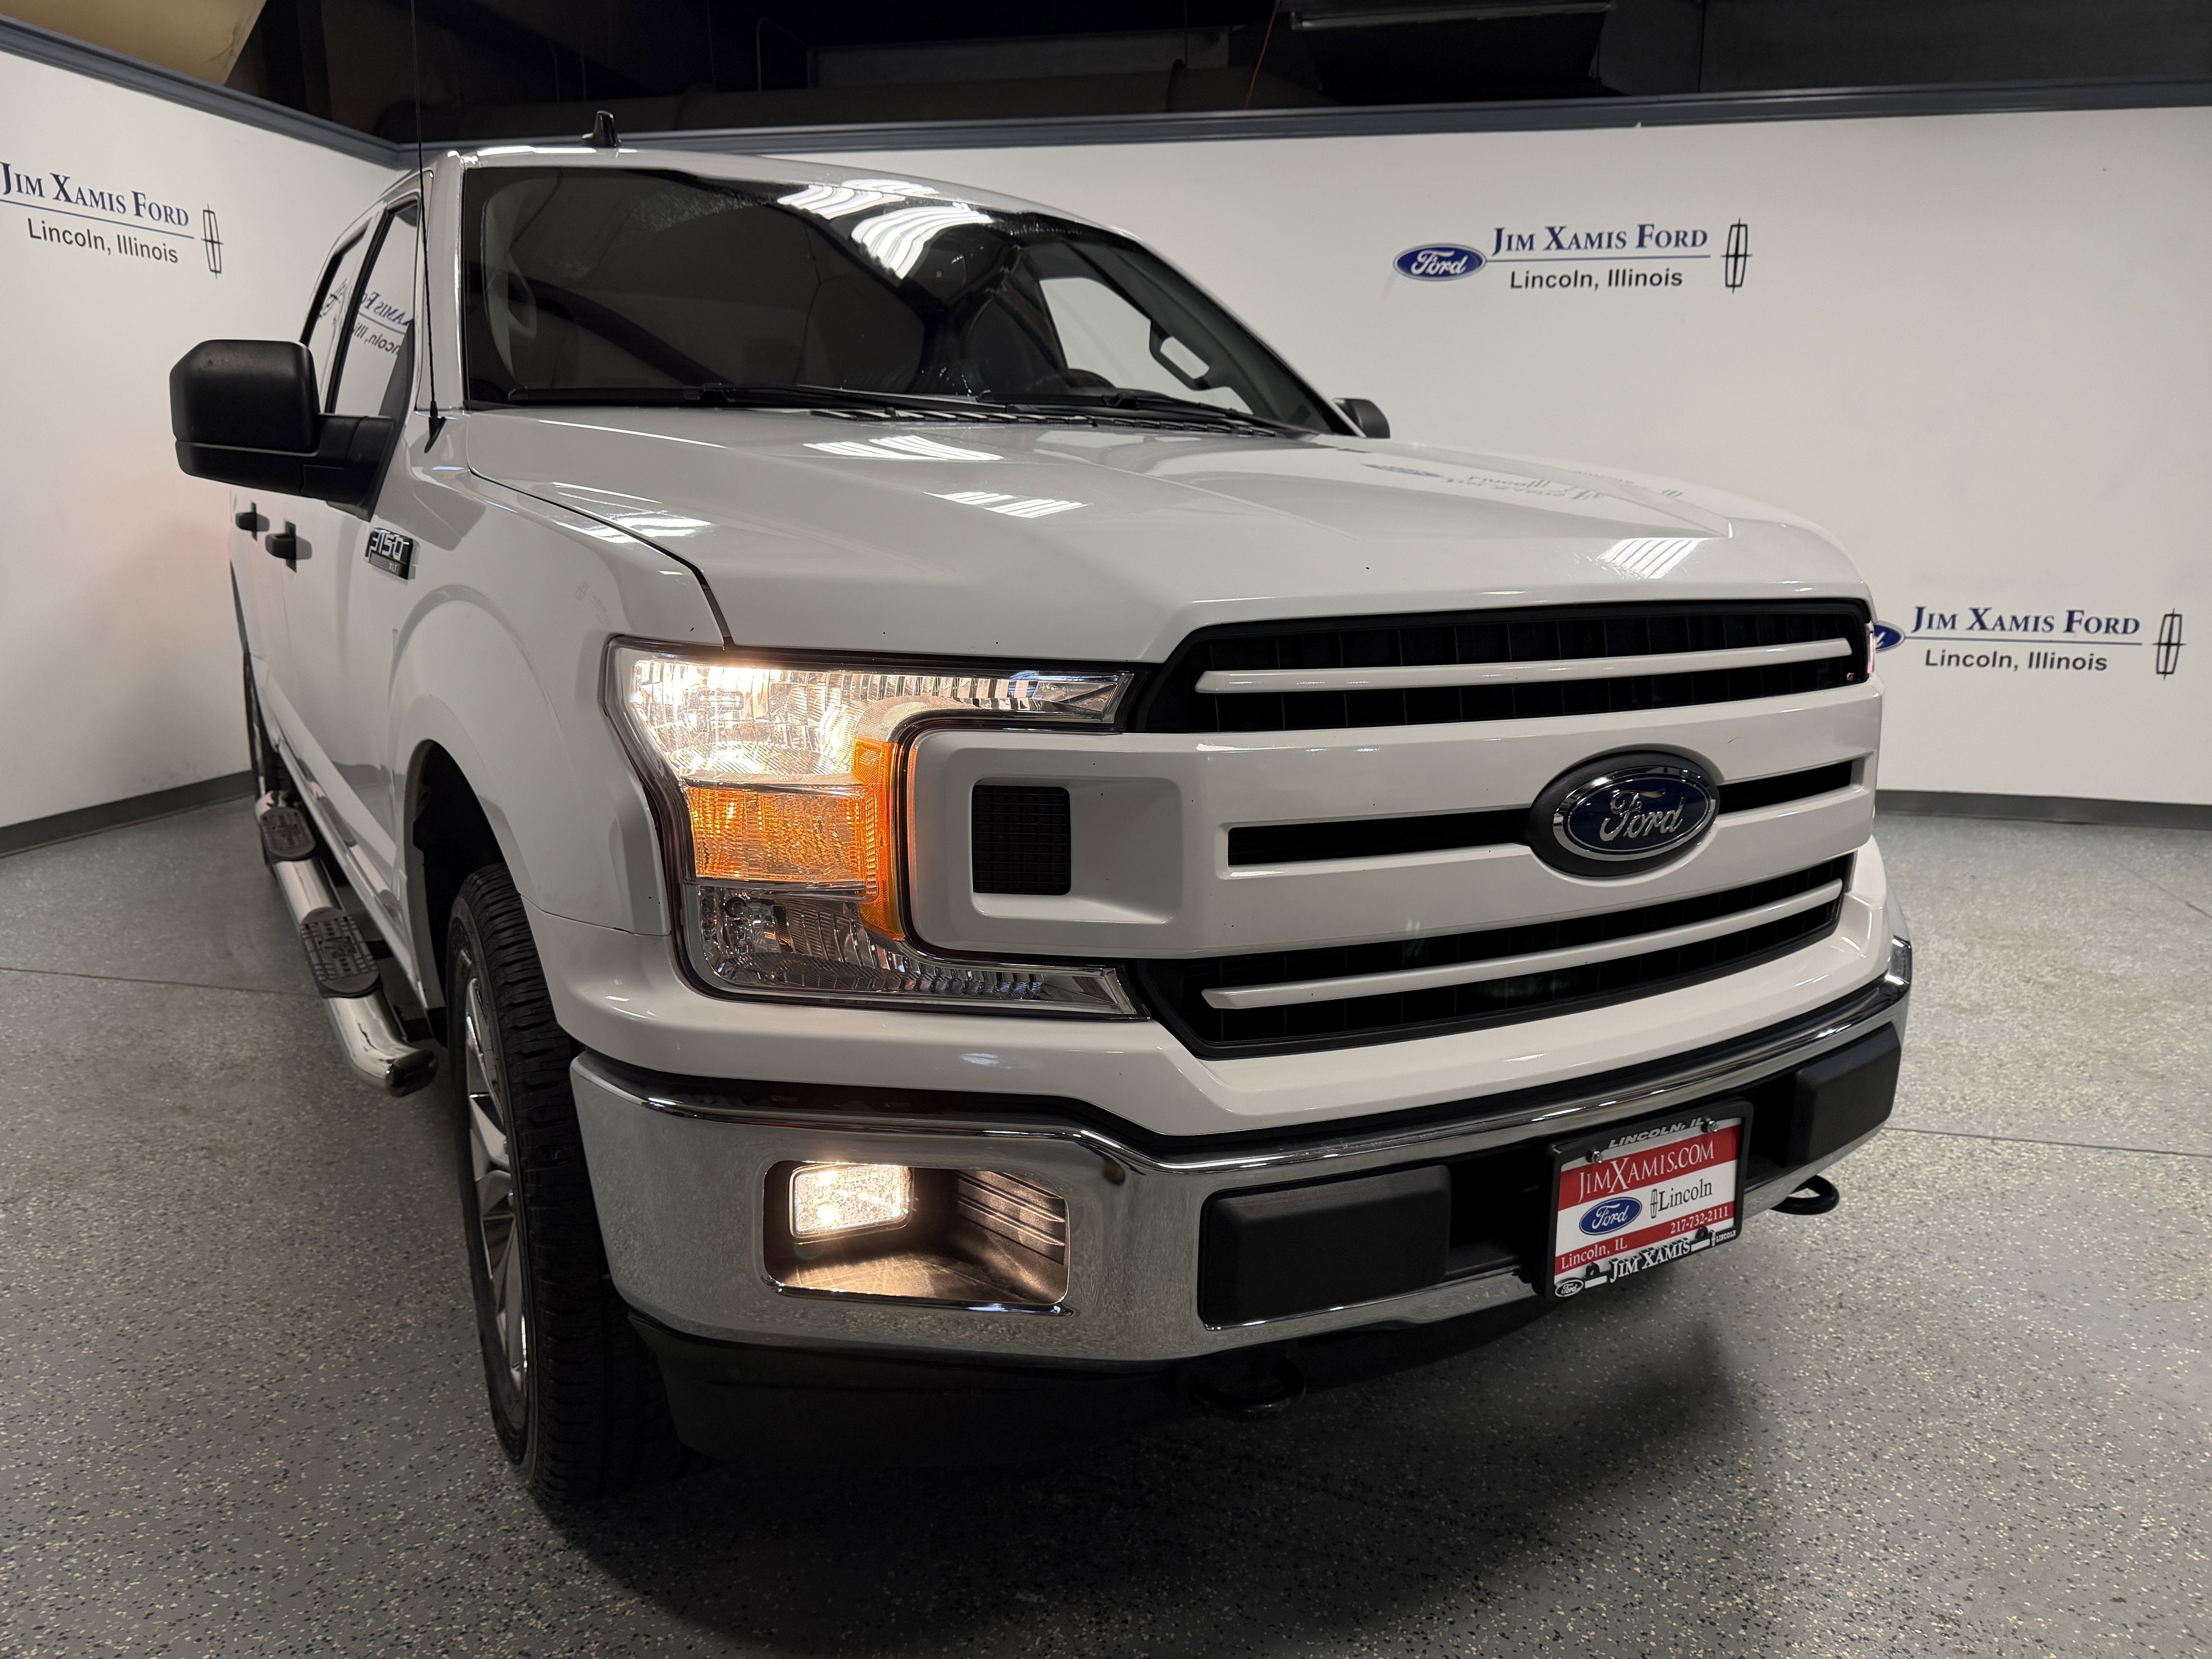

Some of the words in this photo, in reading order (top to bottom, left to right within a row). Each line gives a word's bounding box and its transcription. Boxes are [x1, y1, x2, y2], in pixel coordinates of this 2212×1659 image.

[0, 161, 45, 198] JIM
[50, 173, 126, 214] XAMIS
[131, 190, 189, 226] FORD
[27, 218, 111, 256] Lincoln,
[117, 234, 178, 263] Illinois
[1491, 227, 1535, 256] JIM
[1543, 226, 1627, 251] XAMIS
[1636, 223, 1708, 249] FORD
[1410, 249, 1467, 275] Ford
[1511, 270, 1599, 291] Lincoln,
[1608, 268, 1683, 287] Illinois
[1911, 606, 1959, 633] JIM
[1966, 607, 2055, 632] XAMIS
[2063, 609, 2141, 635] FORD
[1925, 649, 2019, 672] Lincoln,
[2028, 651, 2108, 671] Illinois
[1599, 788, 1686, 842] Ford
[1608, 1123, 1685, 1149] LINCOLN,
[1690, 1117, 1704, 1128] IL
[1578, 1140, 1715, 1203] JIMXAMIS.COM
[1658, 1179, 1712, 1211] Lincoln
[1592, 1203, 1630, 1230] Ford
[1670, 1206, 1728, 1234] 217-732-2111
[1561, 1243, 1610, 1269] Lincoln,
[1615, 1238, 1627, 1250] IL
[1610, 1261, 1639, 1283] JIM
[1642, 1241, 1691, 1270] XAMIS
[1561, 1283, 1578, 1294] Ford
